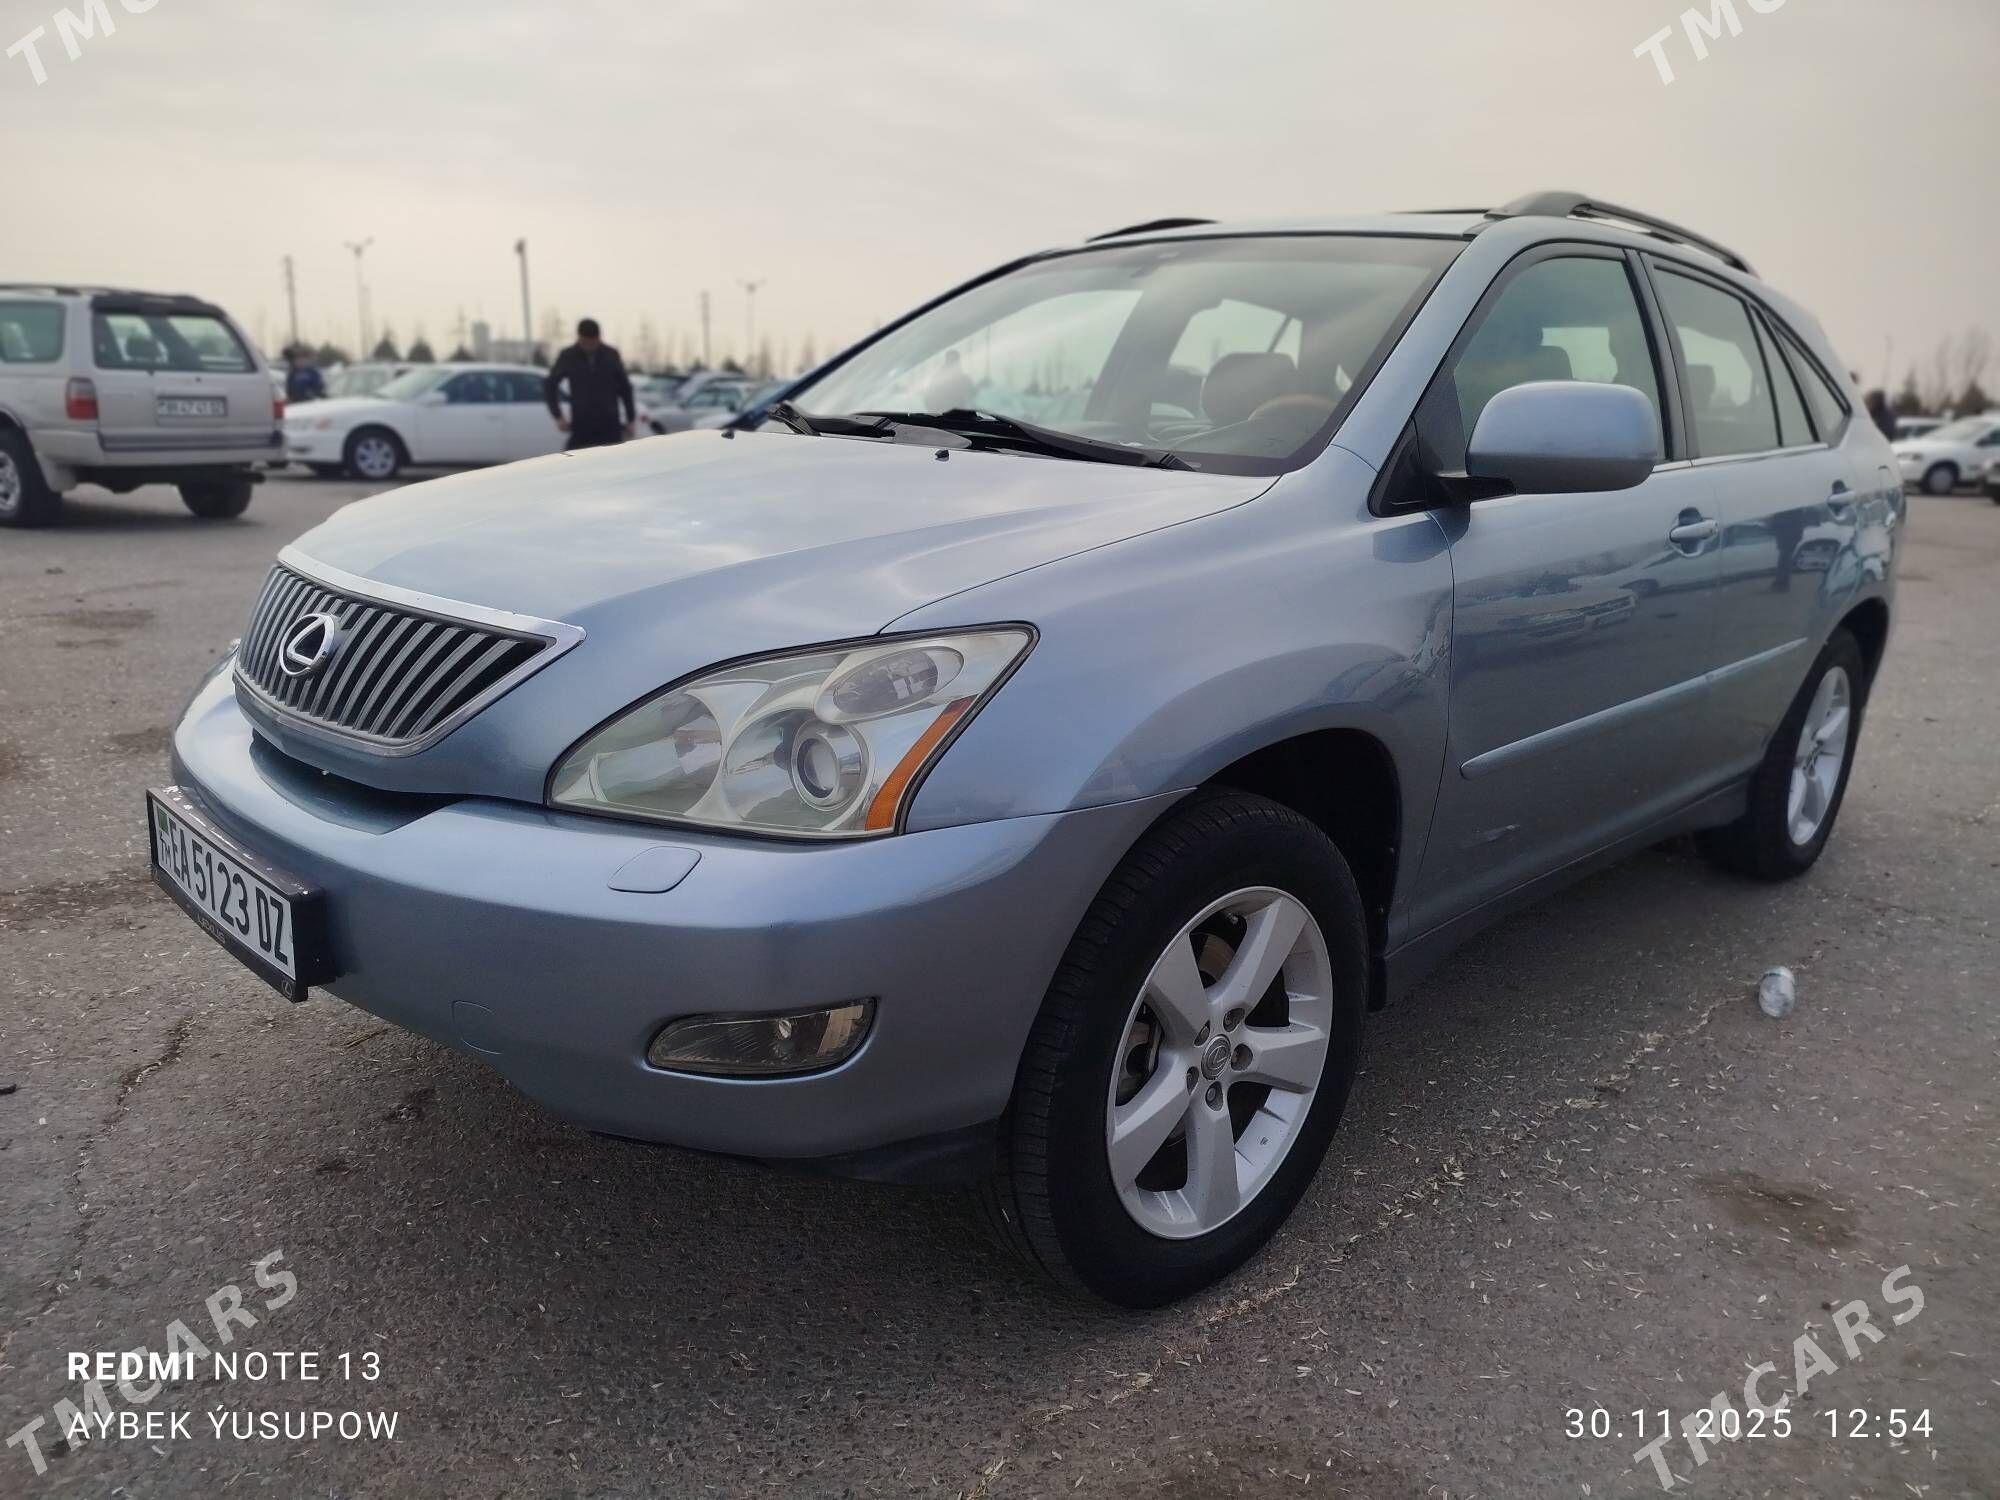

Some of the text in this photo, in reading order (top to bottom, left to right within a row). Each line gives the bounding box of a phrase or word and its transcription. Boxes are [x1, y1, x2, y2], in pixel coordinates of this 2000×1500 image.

[168, 817, 289, 967] EA 5123 DZ
